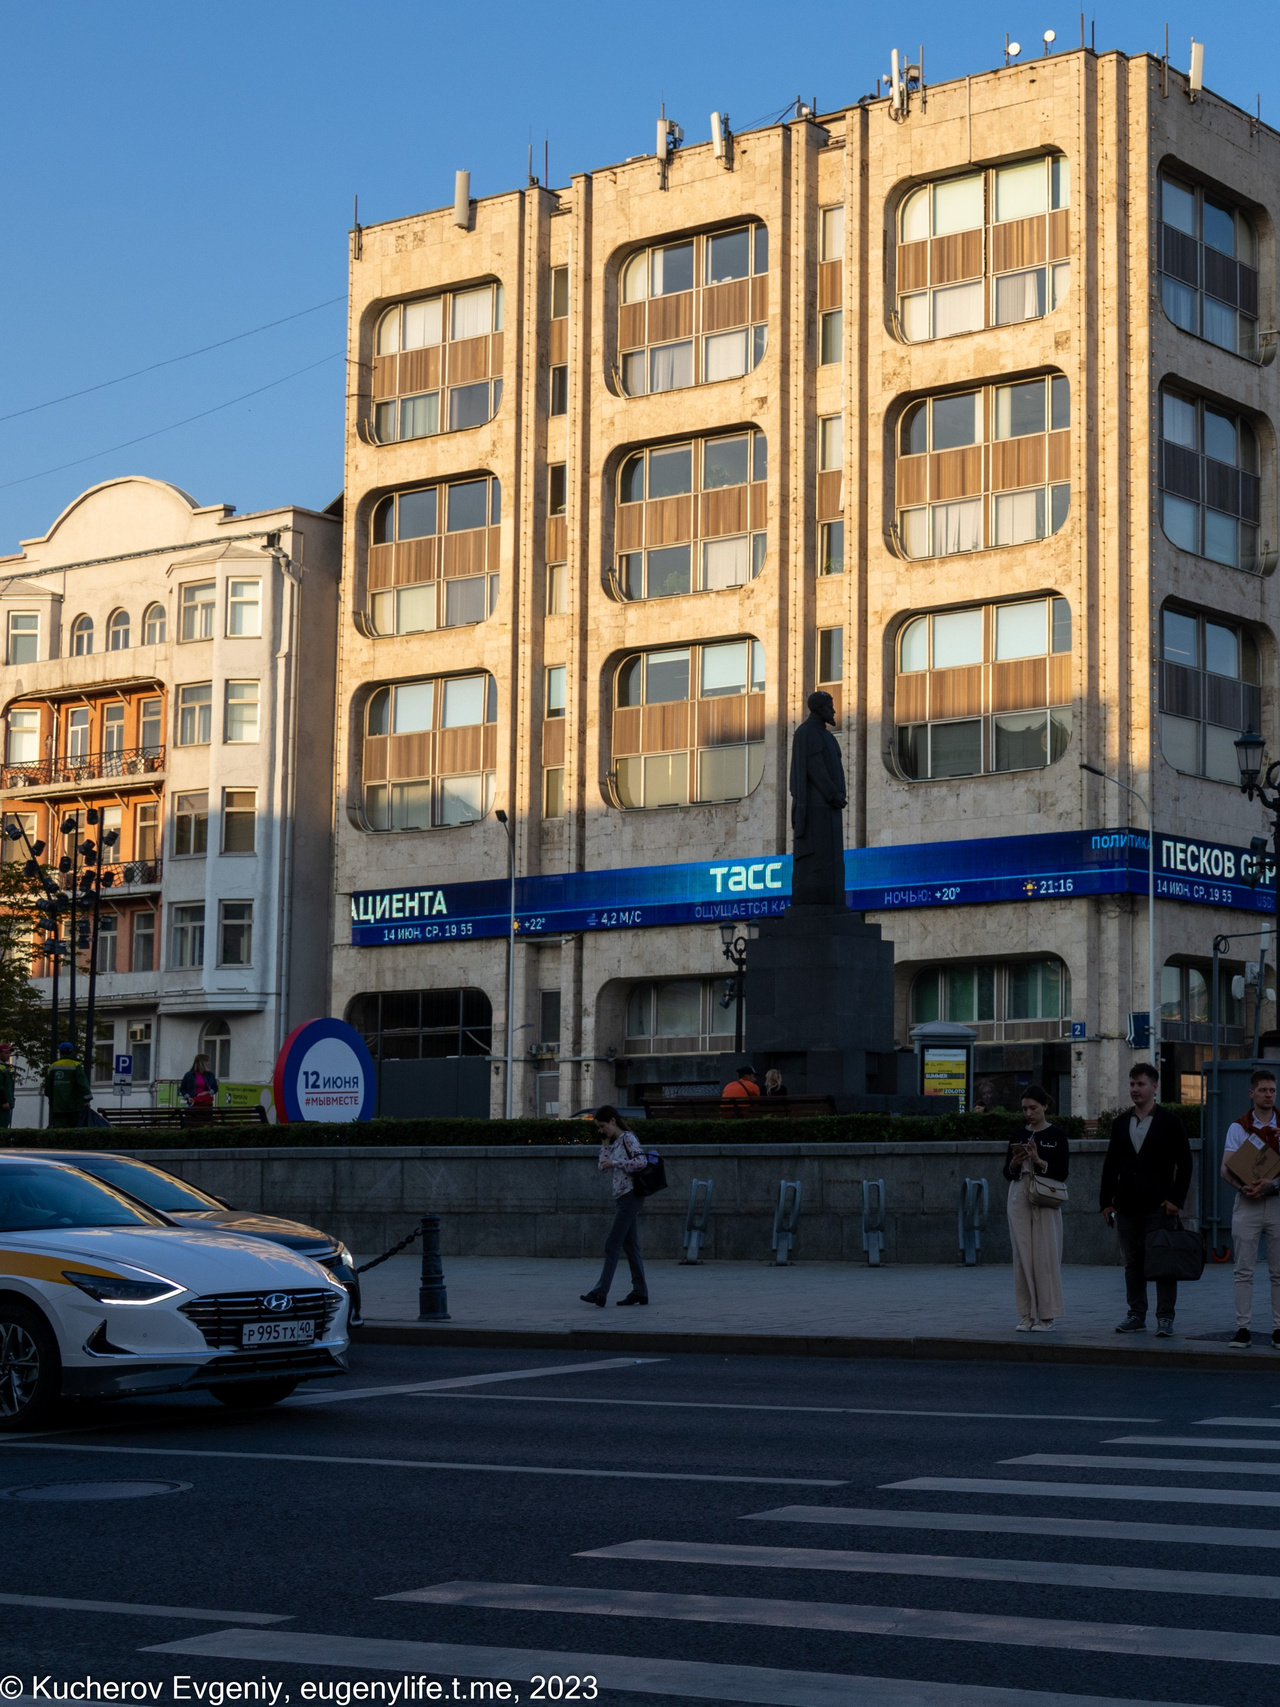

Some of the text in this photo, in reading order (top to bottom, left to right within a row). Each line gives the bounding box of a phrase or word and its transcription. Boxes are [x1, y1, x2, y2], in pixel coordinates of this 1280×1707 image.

[1162, 840, 1236, 878] ПЕСКОВ
[1039, 879, 1074, 894] 21:16
[1157, 879, 1168, 893] 14
[1193, 885, 1207, 899] СР.
[885, 889, 932, 904] НОЧЬЮ:
[695, 901, 769, 919] ОЩУЩАЕТСЯ
[601, 911, 643, 927] 4,2 М/С
[383, 929, 395, 941] 14
[426, 926, 442, 938] СР.
[1075, 1025, 1081, 1035] 2
[303, 1071, 359, 1089] 12 ИЮНЯ
[305, 1096, 359, 1106] #МЫВМЕСТЕ
[300, 1321, 310, 1333] 40
